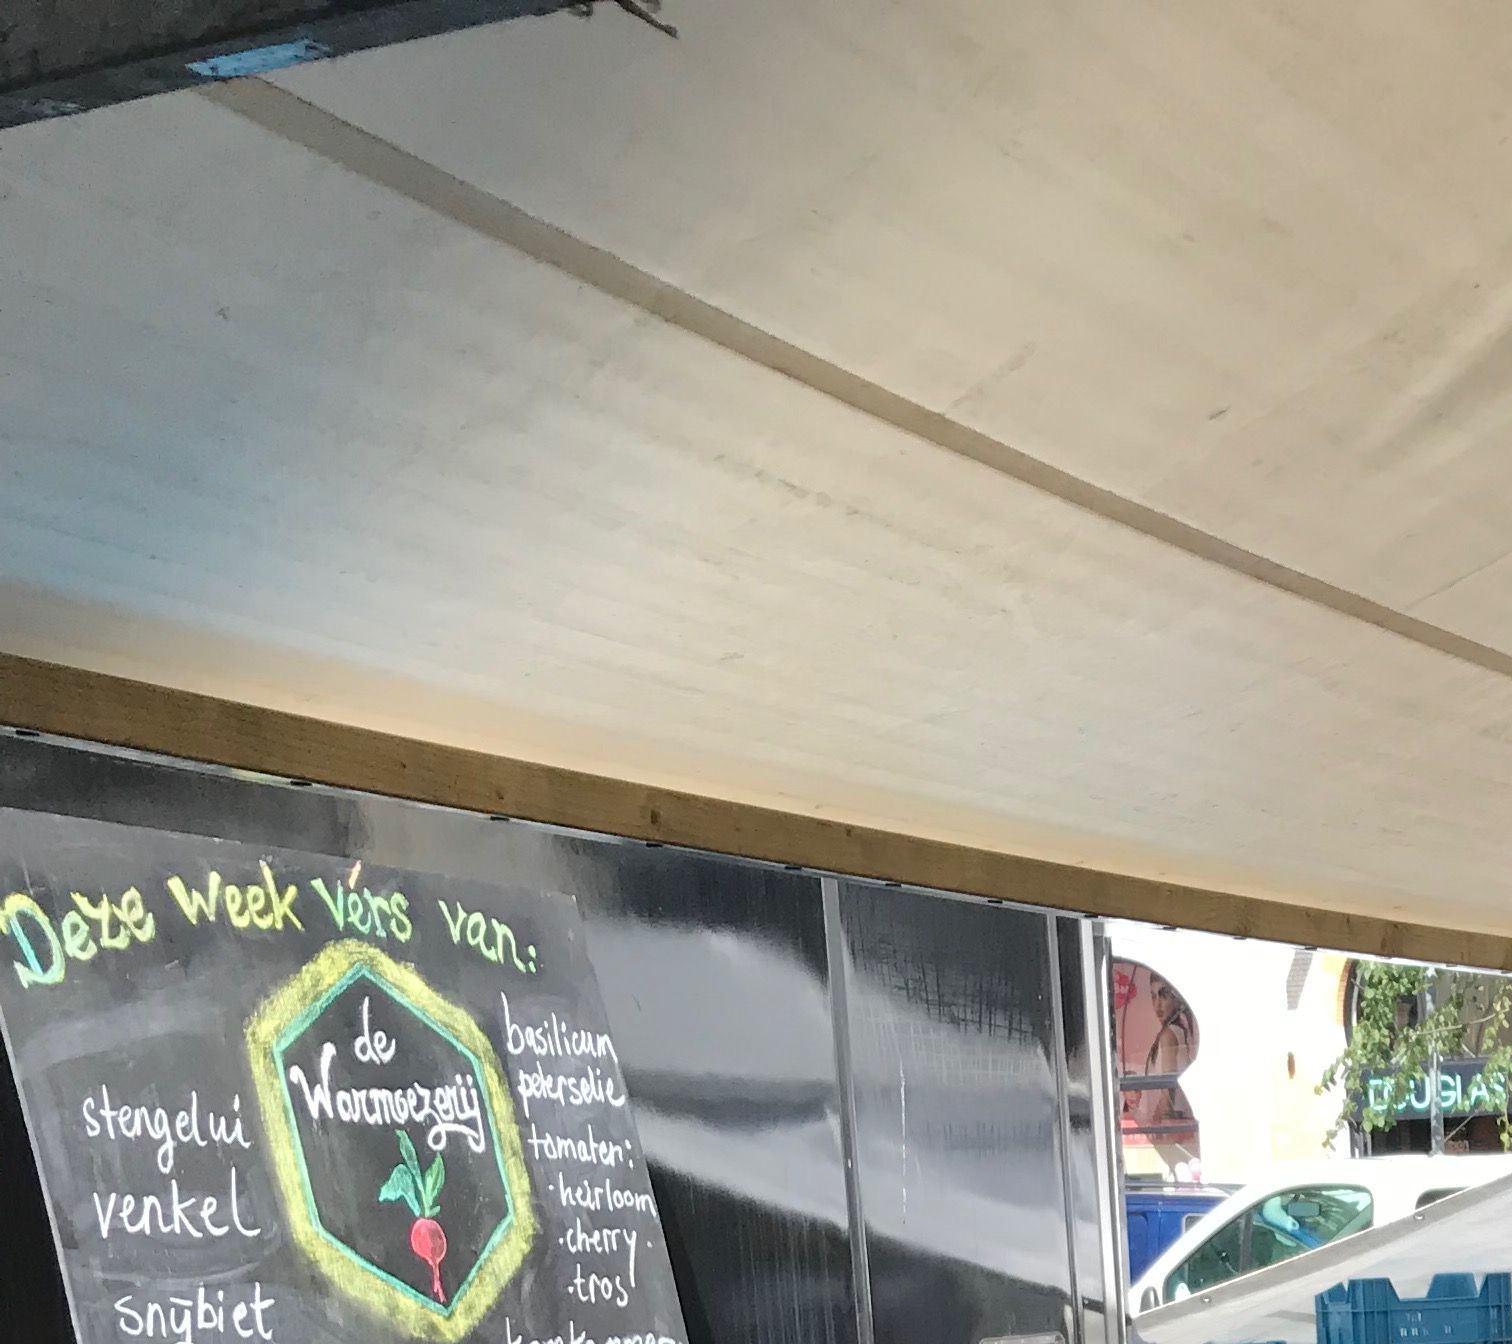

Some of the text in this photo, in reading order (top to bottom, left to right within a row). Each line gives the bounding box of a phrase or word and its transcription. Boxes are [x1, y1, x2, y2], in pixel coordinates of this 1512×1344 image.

[354, 997, 396, 1065] de
[501, 991, 618, 1063] basilicum
[518, 1061, 626, 1119] peterselie
[528, 1123, 634, 1168] tomaten:
[94, 1167, 262, 1240] venkel
[559, 1172, 658, 1218] heirloom
[567, 1217, 637, 1288] cherry
[574, 1263, 628, 1307] tros
